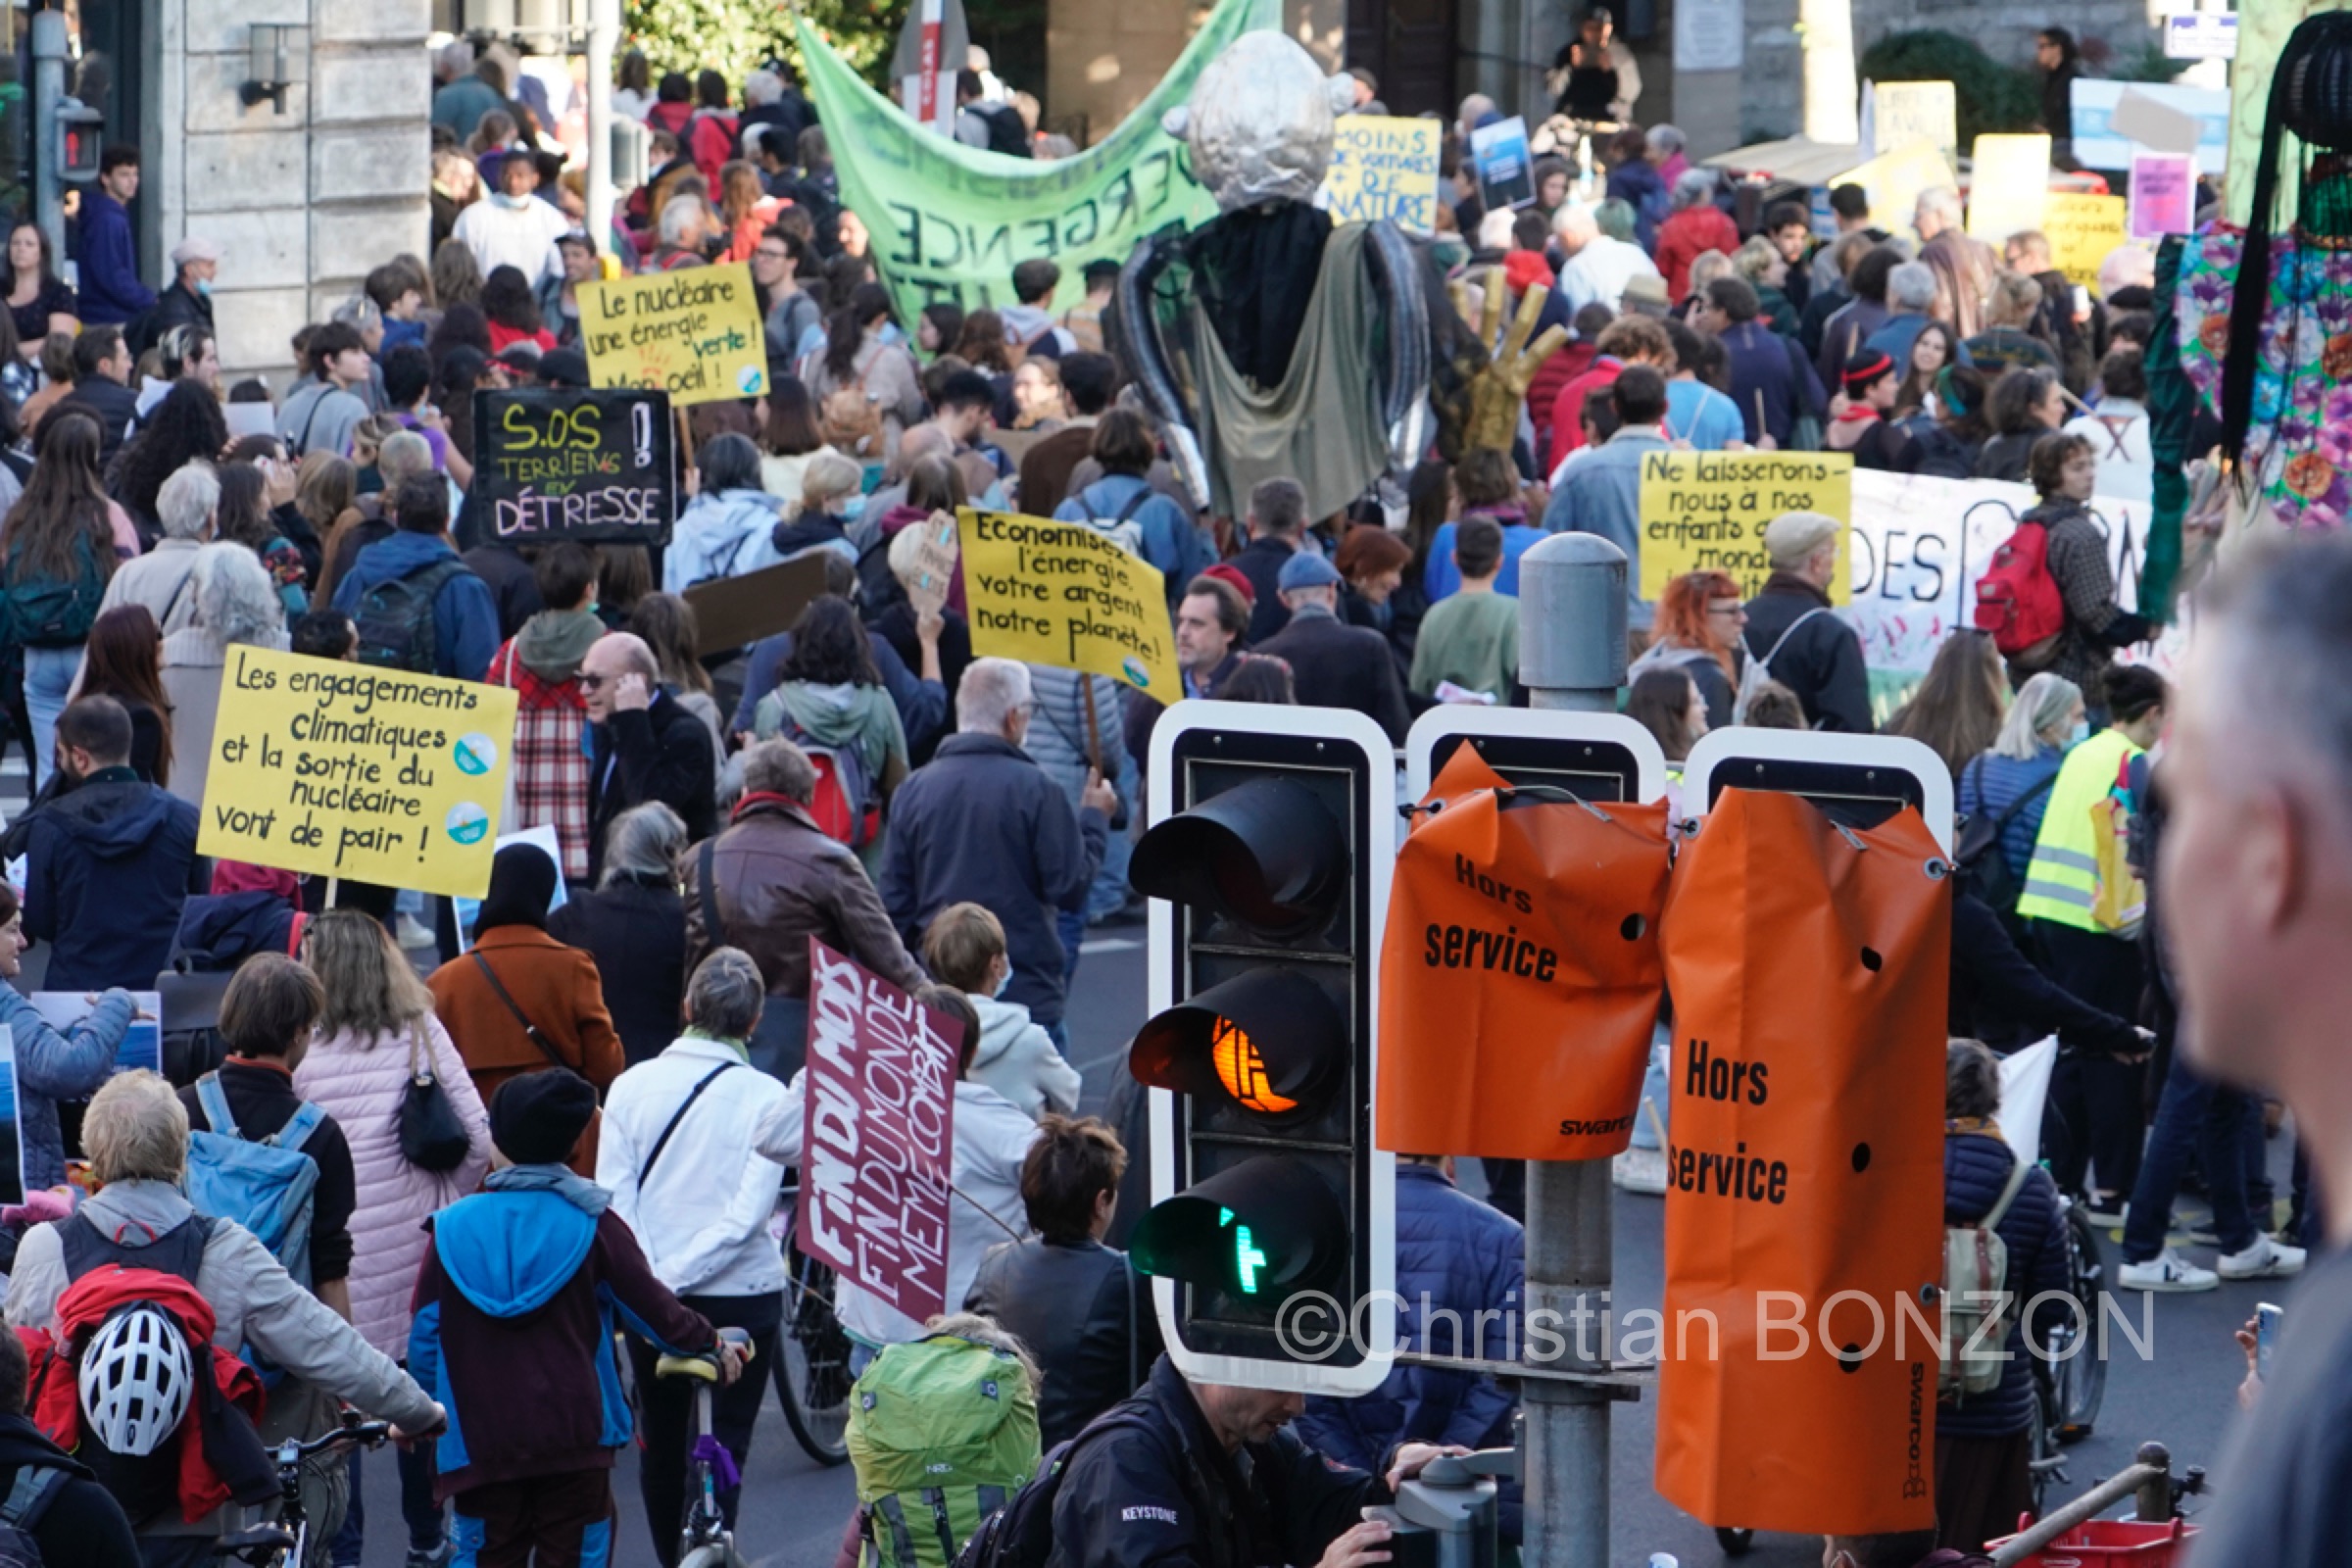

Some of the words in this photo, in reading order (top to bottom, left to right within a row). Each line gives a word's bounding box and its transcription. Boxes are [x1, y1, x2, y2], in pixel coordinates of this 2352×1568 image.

[1326, 190, 1433, 229] NATURE
[600, 285, 627, 319] Le
[635, 275, 734, 316] nucléaire
[589, 330, 624, 357] une
[630, 311, 709, 347] énergie
[692, 324, 747, 359] verte
[1646, 454, 1684, 482] Ne
[495, 485, 662, 536] DÉTRESSE
[1669, 490, 1732, 513] nous
[1740, 486, 1758, 511] à
[1771, 491, 1814, 512] nos
[1648, 514, 1742, 550] enfants
[1693, 539, 1772, 570] mond
[977, 573, 1051, 601] votre
[977, 607, 1051, 636] notre
[236, 651, 276, 690] Les
[289, 671, 478, 713] engagements
[221, 735, 249, 763] et
[261, 733, 282, 768] la
[296, 752, 381, 783] sortie
[397, 753, 433, 787] du
[289, 779, 420, 817] nucléaire
[289, 810, 323, 848] de
[334, 826, 403, 867] pair
[1454, 852, 1533, 914] Hors
[1424, 923, 1558, 982] service
[863, 977, 914, 1142] MONDE
[1685, 1038, 1769, 1106] Hors
[811, 1069, 860, 1159] DU
[859, 1125, 908, 1205] DU
[901, 1145, 949, 1300] MEME
[1910, 1361, 1924, 1461] swarco
[1121, 1505, 1178, 1525] KEYSTONE
